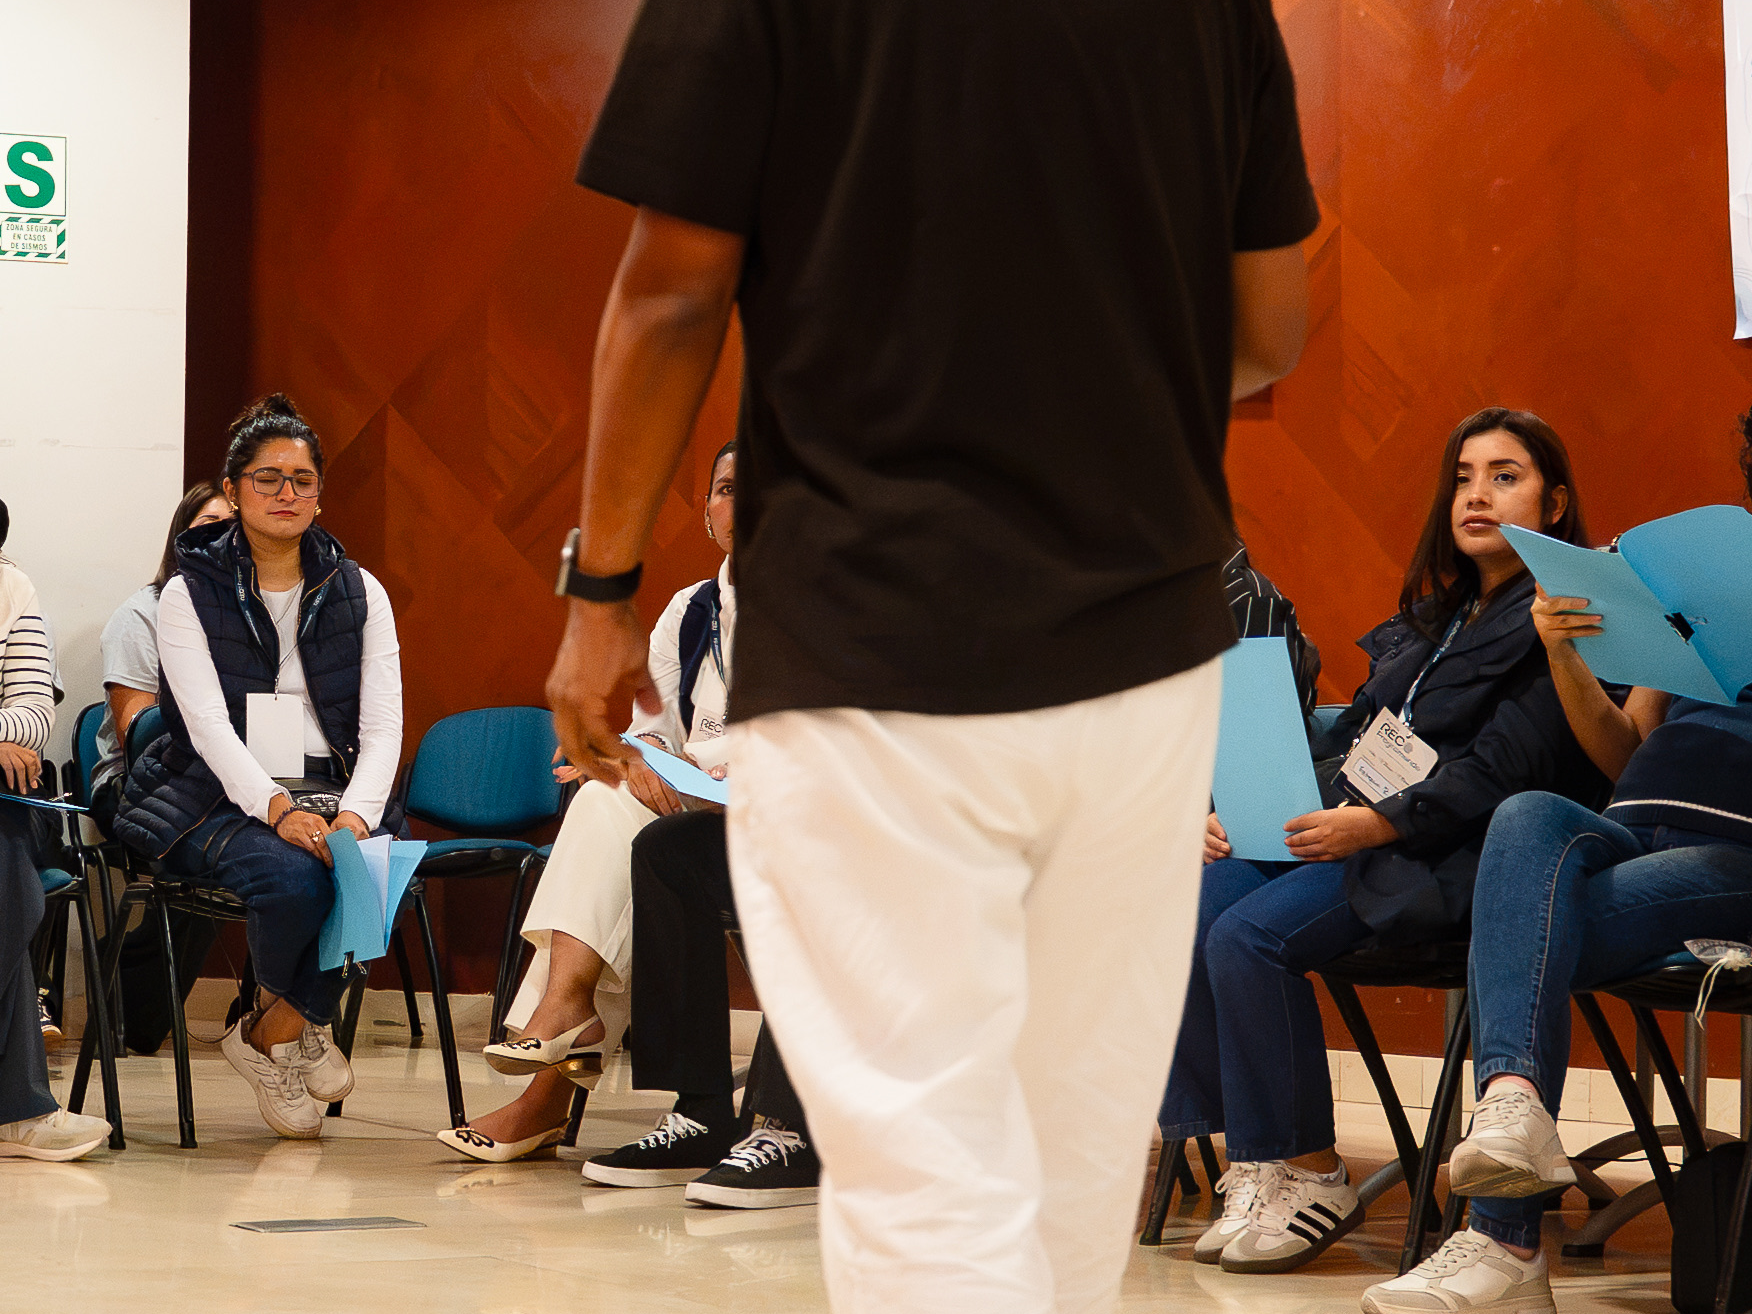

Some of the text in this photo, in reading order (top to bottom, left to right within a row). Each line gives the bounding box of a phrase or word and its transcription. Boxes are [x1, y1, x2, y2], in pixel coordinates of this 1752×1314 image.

[5, 141, 55, 208] S
[26, 224, 52, 233] SEGURA
[24, 234, 46, 242] CASOS
[22, 243, 48, 251] SISMOS
